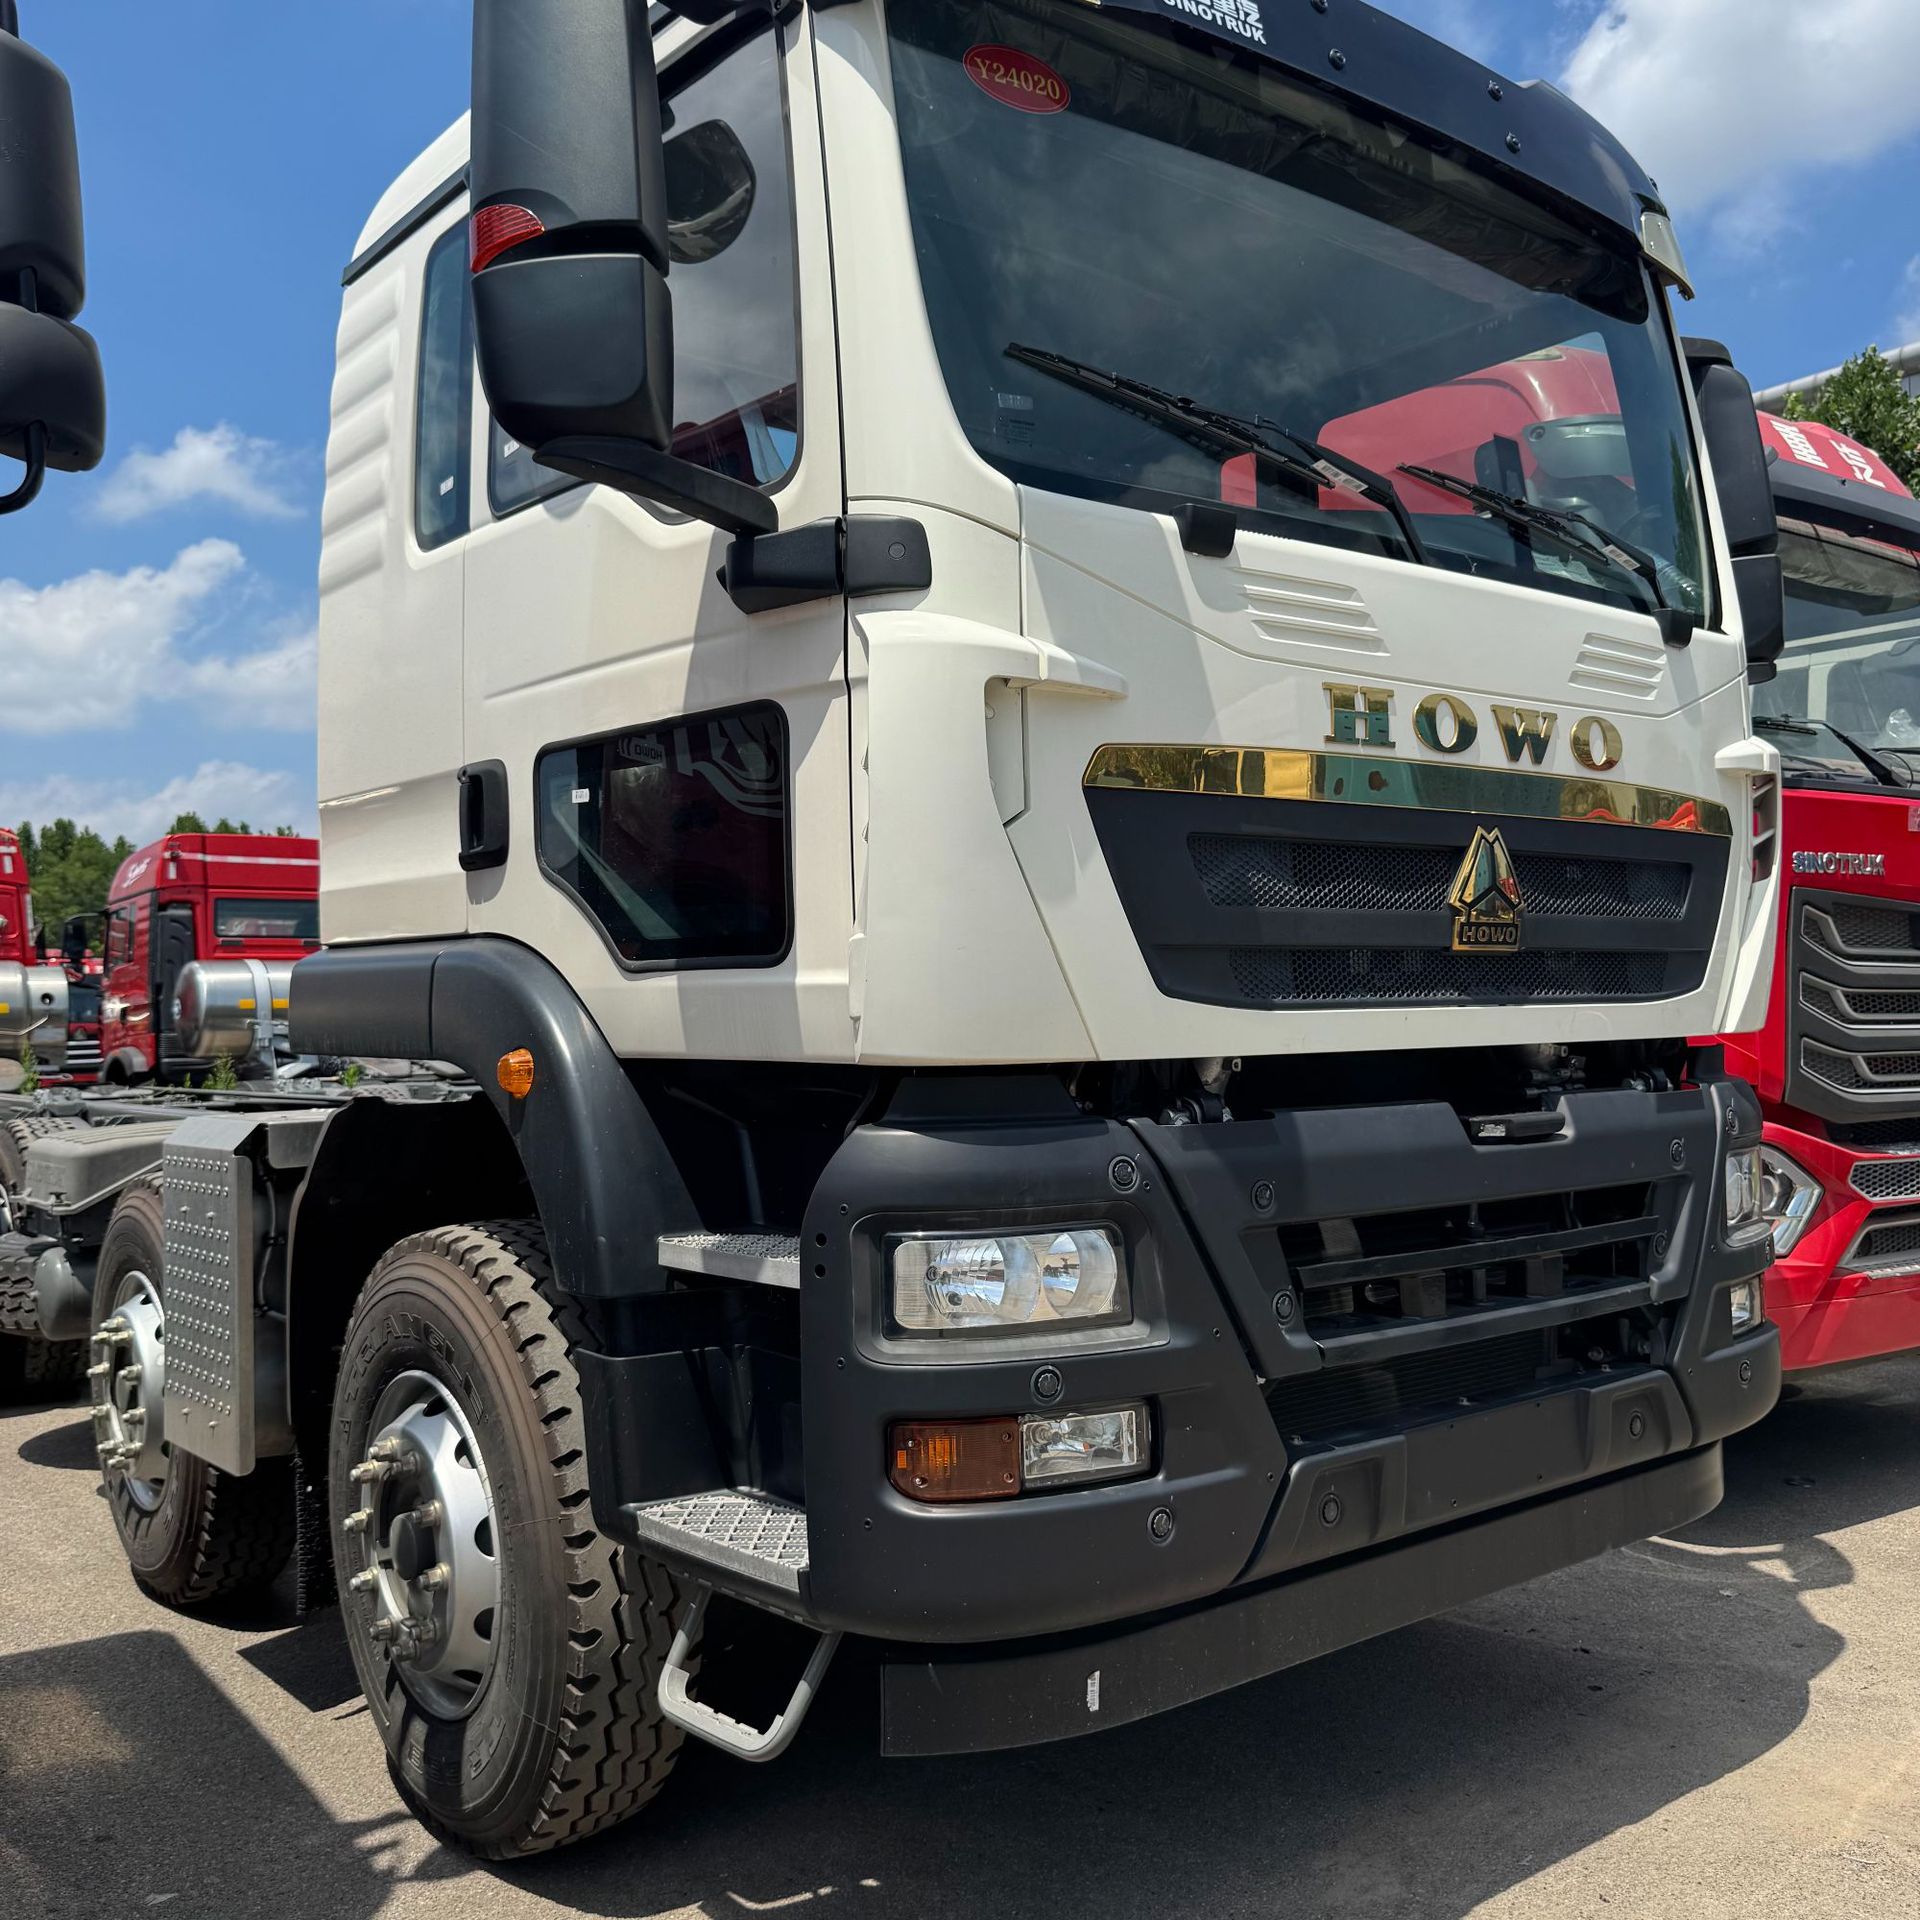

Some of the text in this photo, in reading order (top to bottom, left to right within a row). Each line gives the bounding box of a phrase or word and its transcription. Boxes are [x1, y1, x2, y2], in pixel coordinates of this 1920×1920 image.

[974, 56, 1060, 100] Y24020
[1322, 681, 1623, 771] HOWO
[1792, 851, 1885, 875] SINOTRUK
[1462, 925, 1517, 943] HOWO
